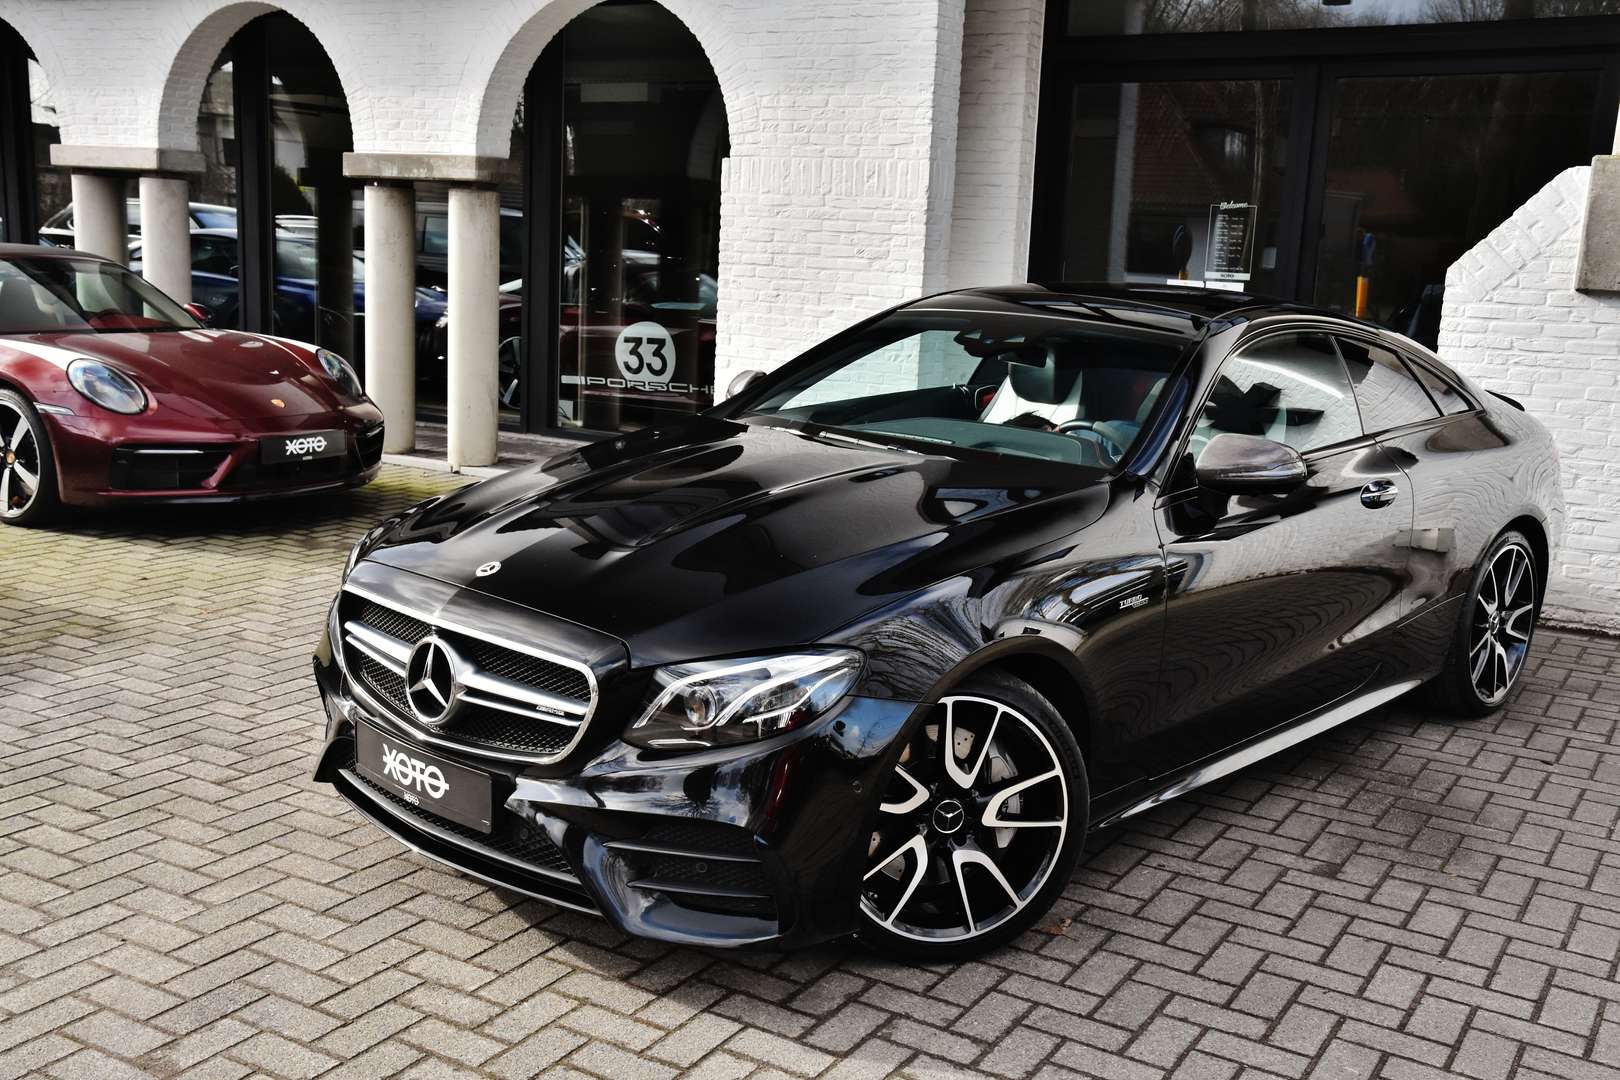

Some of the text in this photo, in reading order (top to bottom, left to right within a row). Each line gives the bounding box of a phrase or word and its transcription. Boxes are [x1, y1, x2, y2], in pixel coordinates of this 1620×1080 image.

[1220, 201, 1248, 210] Welcome
[623, 336, 668, 377] 33
[285, 436, 327, 455] XOTO
[382, 743, 450, 799] XOTO
